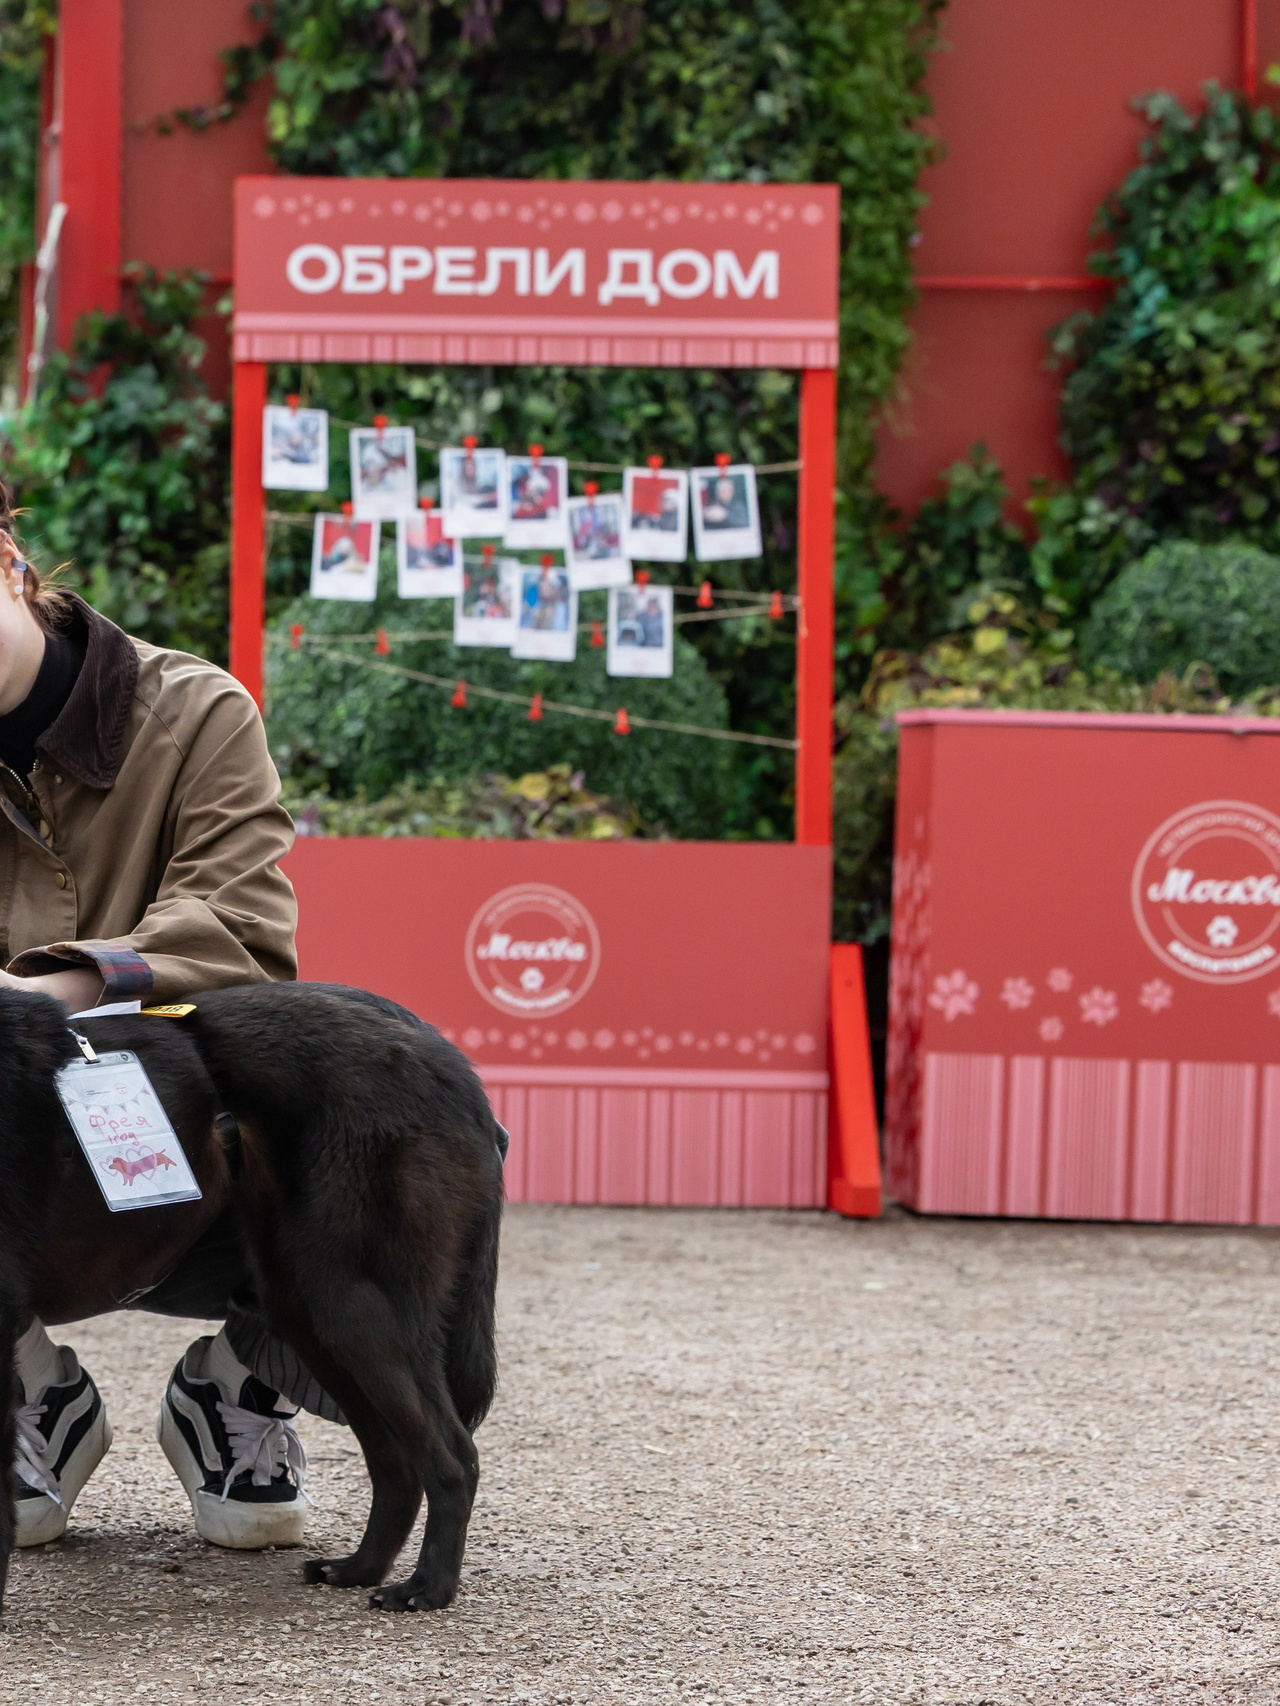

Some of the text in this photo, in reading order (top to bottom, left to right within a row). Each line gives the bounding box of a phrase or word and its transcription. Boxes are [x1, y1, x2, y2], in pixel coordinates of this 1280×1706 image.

[286, 243, 780, 306] ОБРЕЛИ ДОМ
[89, 1115, 152, 1136] Фрея
